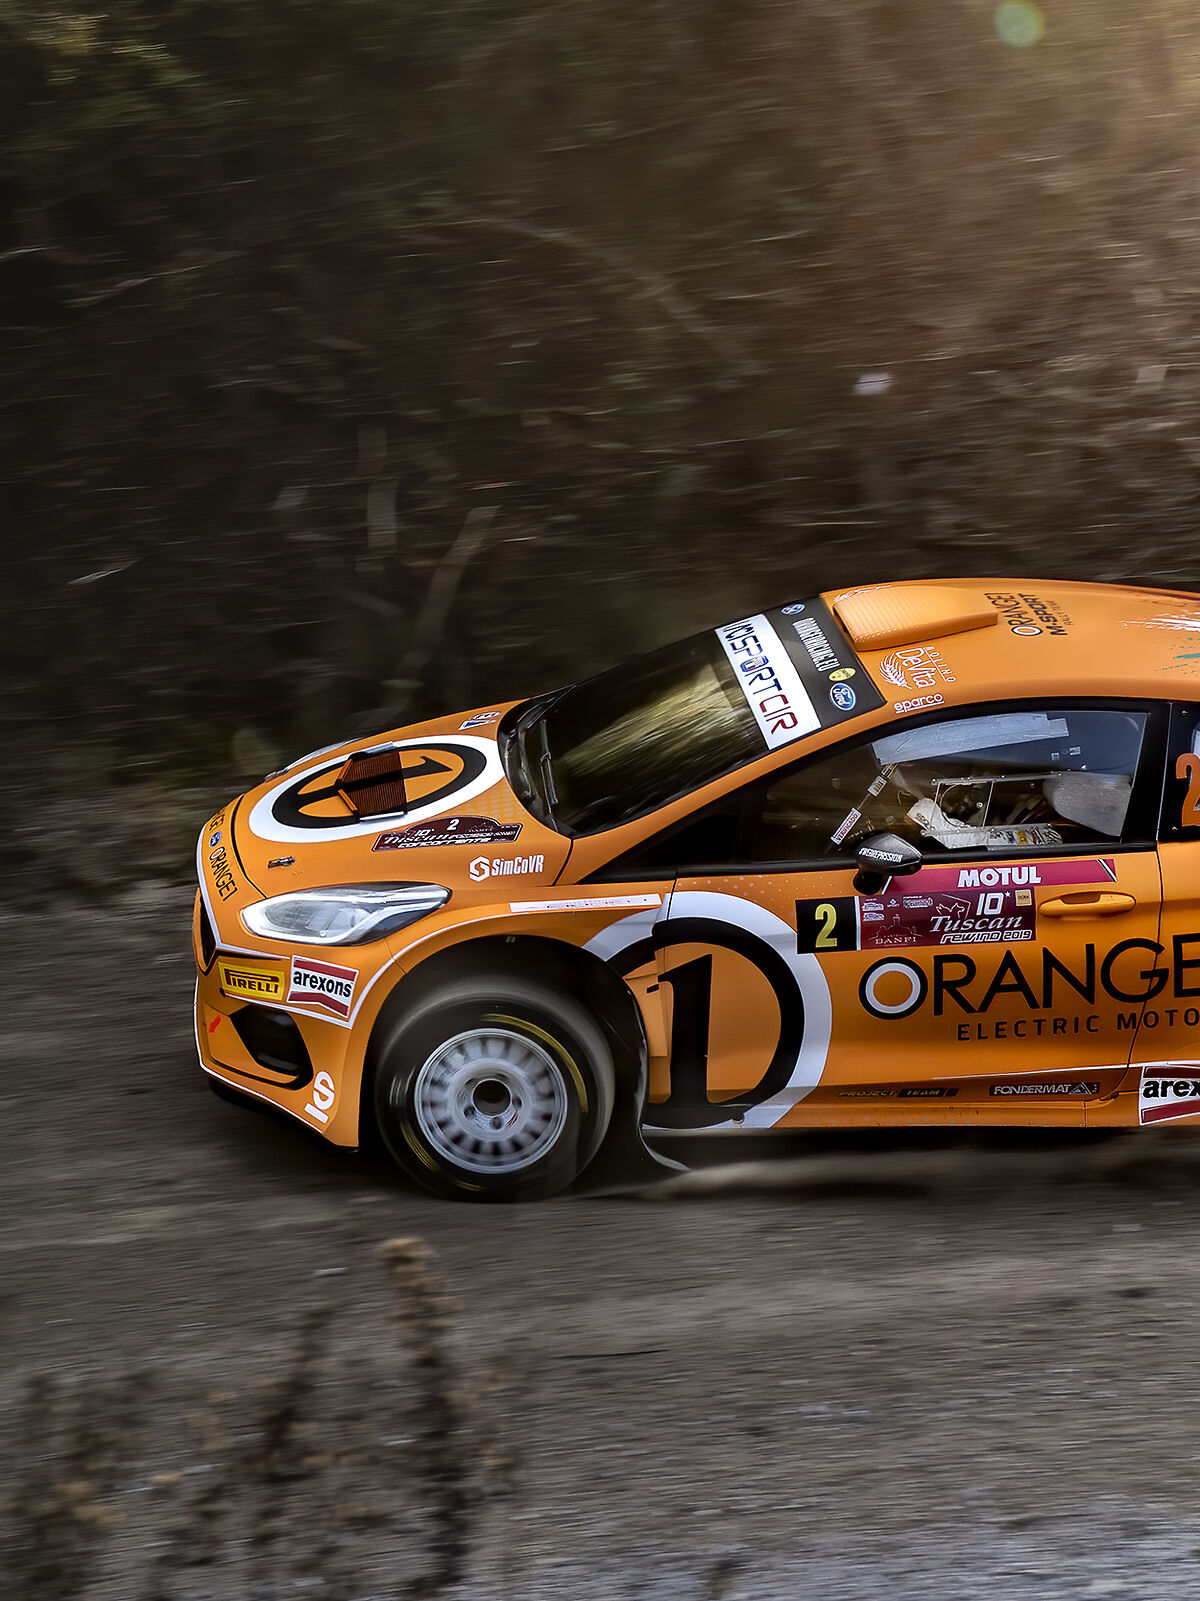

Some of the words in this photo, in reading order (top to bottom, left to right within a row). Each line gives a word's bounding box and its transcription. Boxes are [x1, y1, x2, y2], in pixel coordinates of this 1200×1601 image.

[447, 818, 460, 831] 2
[209, 846, 238, 901] ORANGE1
[491, 854, 545, 876] SimCoVR
[957, 866, 1042, 888] MOTUL
[814, 902, 839, 948] 2
[929, 915, 1023, 933] Tuscan
[1002, 930, 1033, 941] 2019
[224, 968, 280, 993] PIRELLI
[293, 970, 352, 998] arexons
[957, 1014, 1100, 1041] ELECTRIC
[993, 1083, 1072, 1096] FONDERMAT
